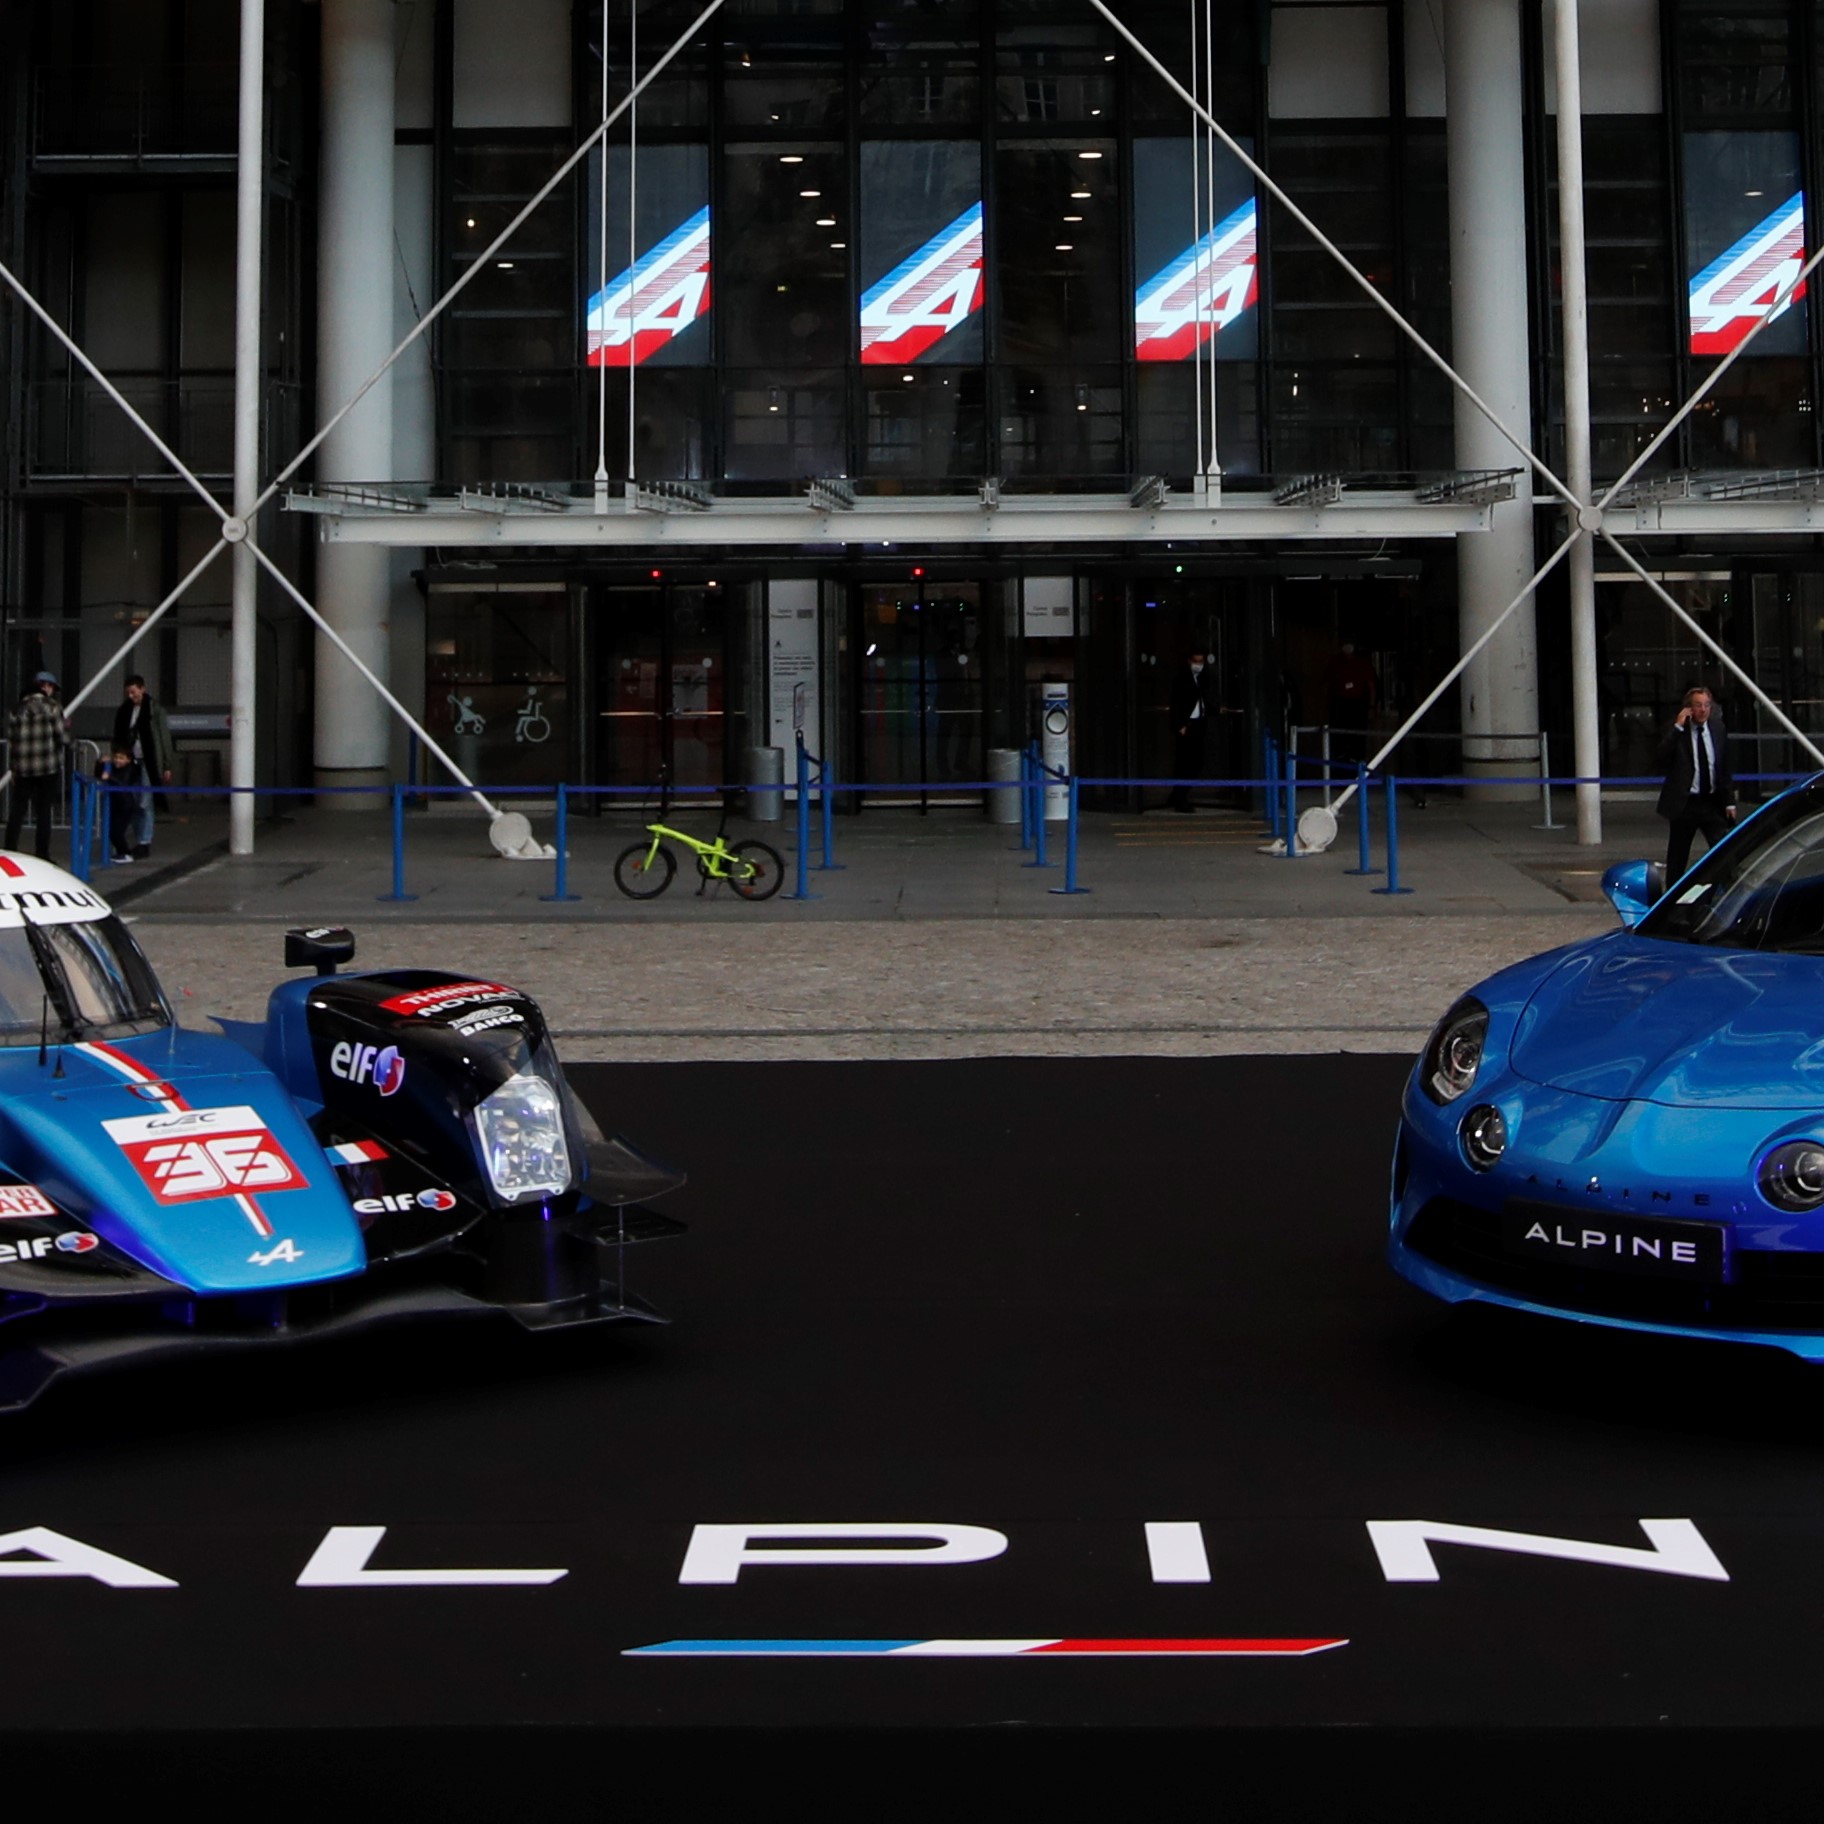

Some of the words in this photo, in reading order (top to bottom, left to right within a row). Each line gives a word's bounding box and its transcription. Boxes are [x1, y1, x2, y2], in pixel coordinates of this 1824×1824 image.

[460, 1014, 525, 1036] BAHCO
[330, 1041, 378, 1084] elf
[143, 1135, 293, 1197] 36
[353, 1193, 417, 1213] elf
[1524, 1221, 1697, 1263] ALPINE
